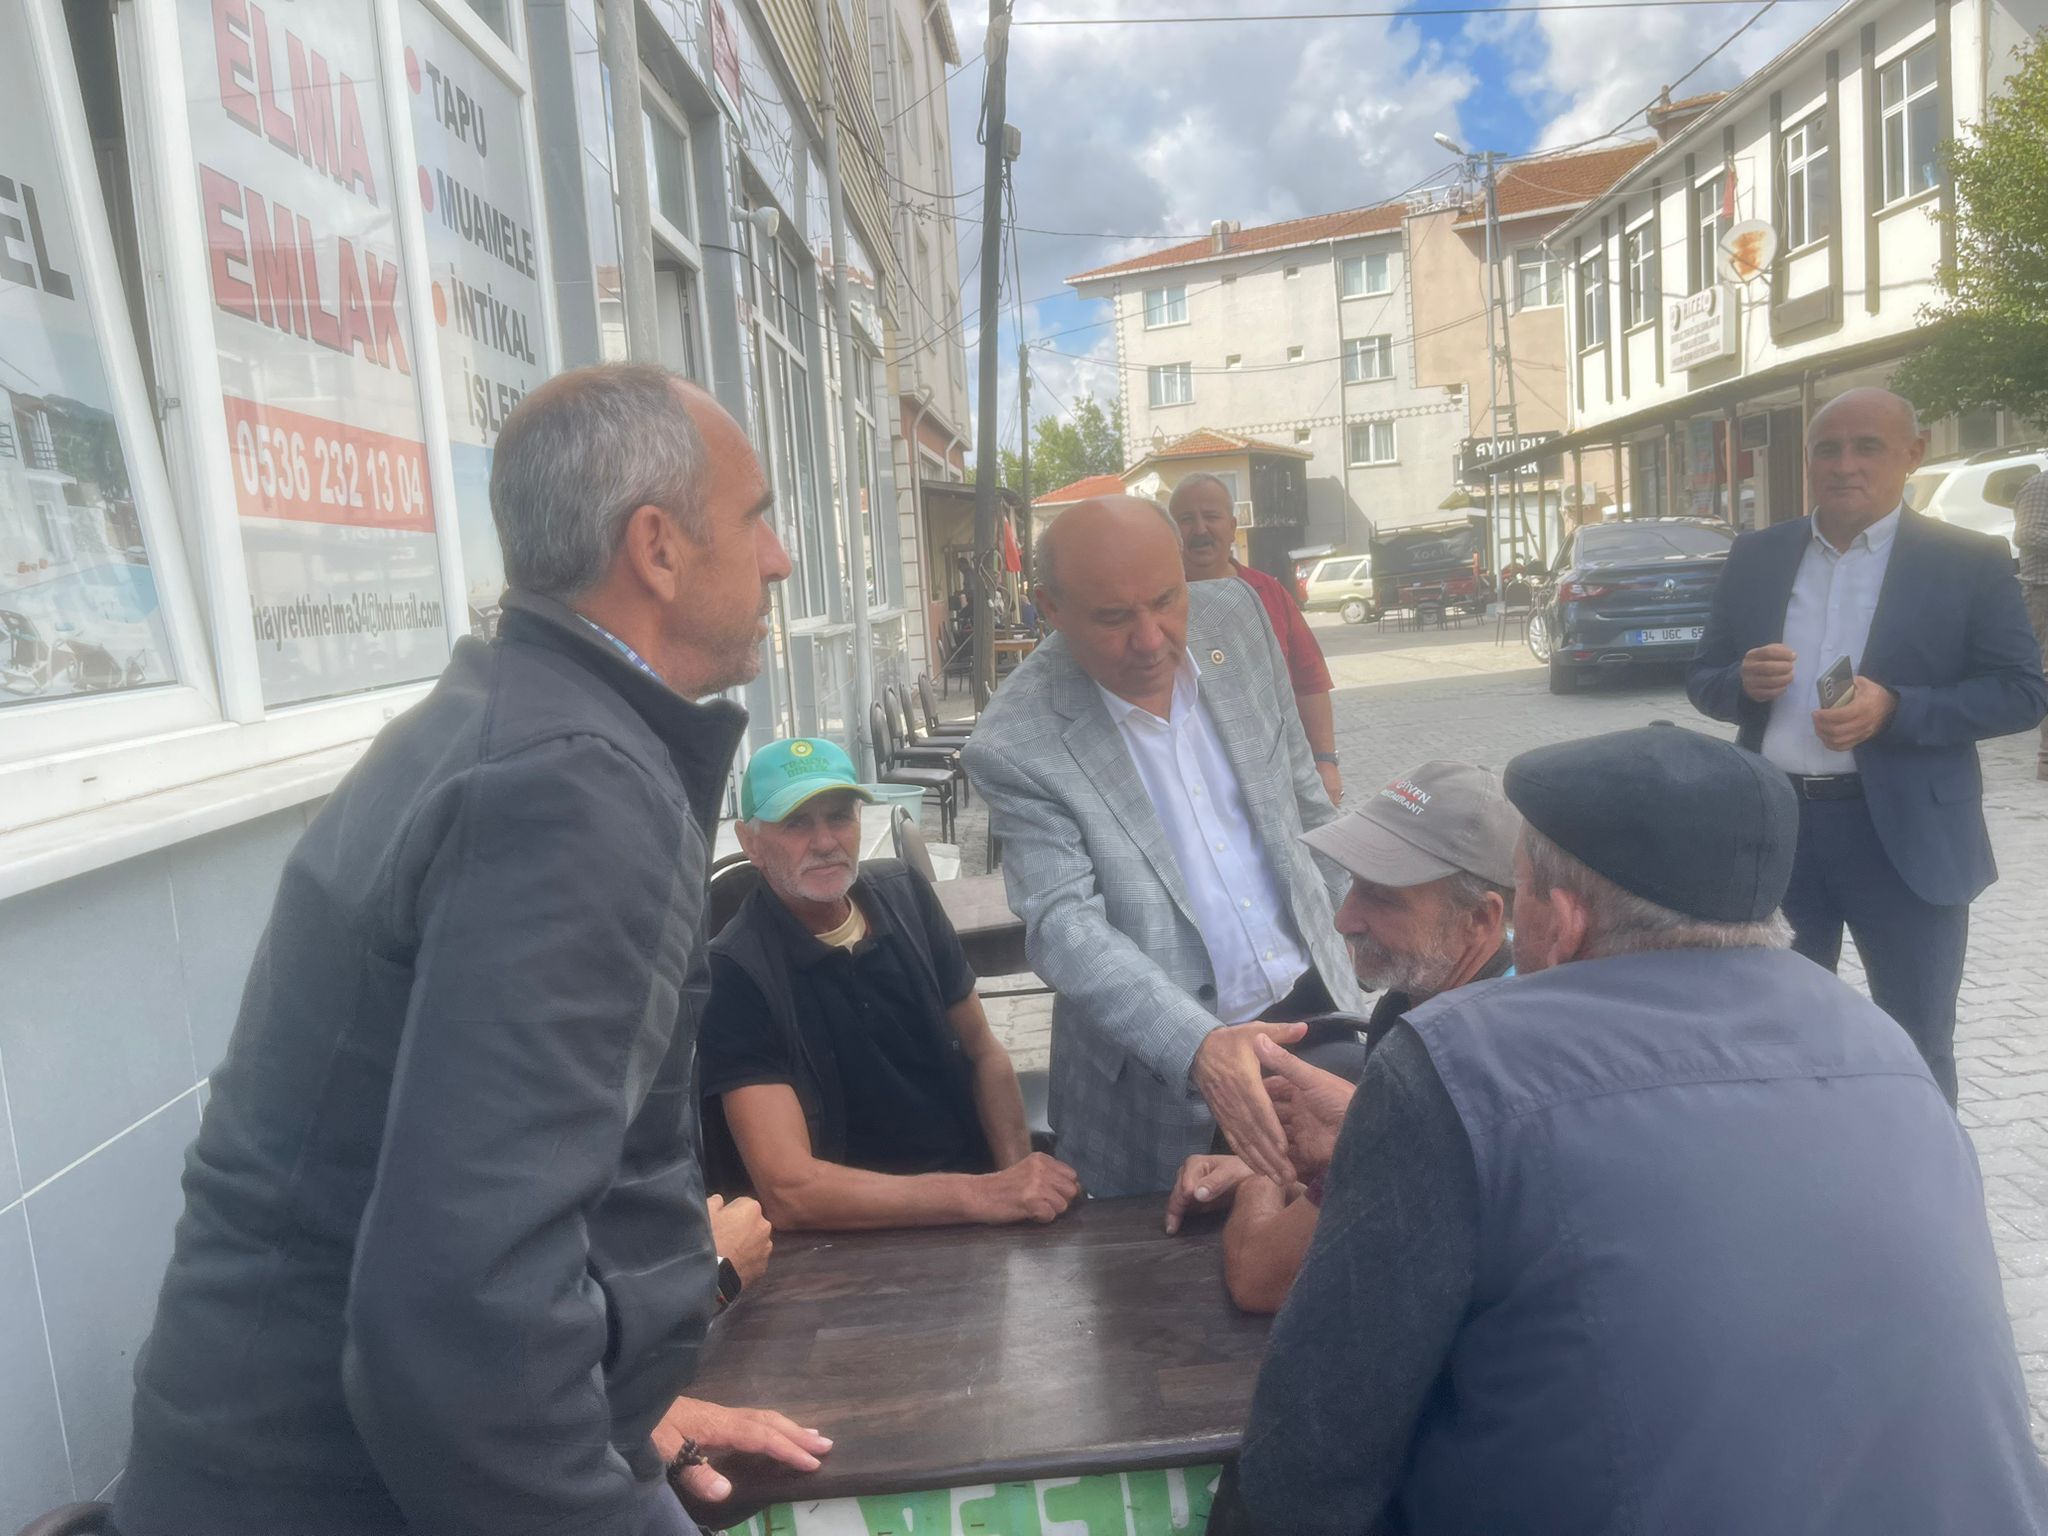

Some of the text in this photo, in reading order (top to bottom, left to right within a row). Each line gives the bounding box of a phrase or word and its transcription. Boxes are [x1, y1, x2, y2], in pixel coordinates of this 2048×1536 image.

[212, 0, 380, 208] ELMA
[425, 60, 487, 158] TAPU
[199, 162, 411, 376] EMLAK
[436, 168, 536, 281] MUAMELE
[449, 262, 536, 366] İNTİKAL
[237, 420, 424, 515] 0536 232 13 04
[250, 592, 443, 652] hayrettinelma34@hotmail.com
[1642, 631, 1655, 641] 34
[1662, 629, 1682, 640] UGC
